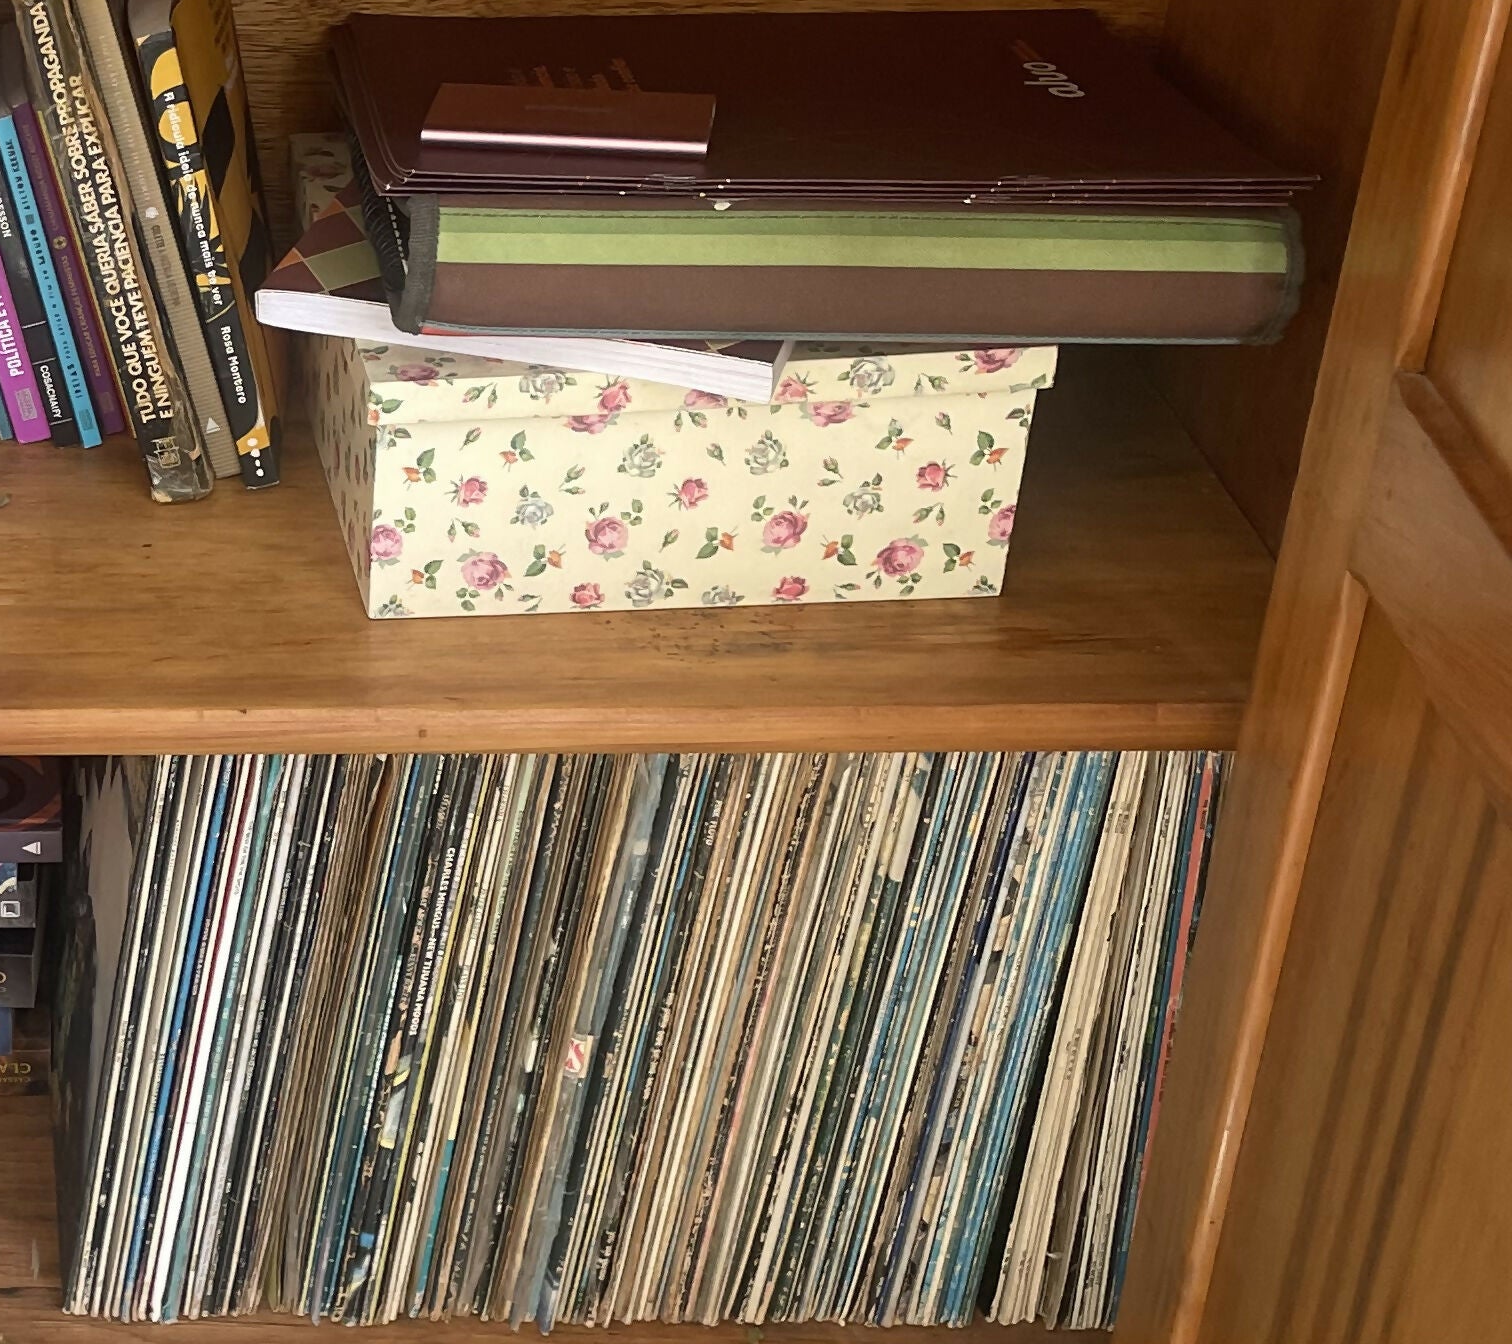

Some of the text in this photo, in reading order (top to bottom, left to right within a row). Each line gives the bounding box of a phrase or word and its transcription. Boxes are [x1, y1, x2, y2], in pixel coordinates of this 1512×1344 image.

[220, 325, 247, 404] Rosa Montero
[439, 847, 456, 891] CHARLES
[431, 891, 446, 929] MINGUS
[426, 937, 437, 959] NEW
[416, 959, 433, 1003] TIJUANA
